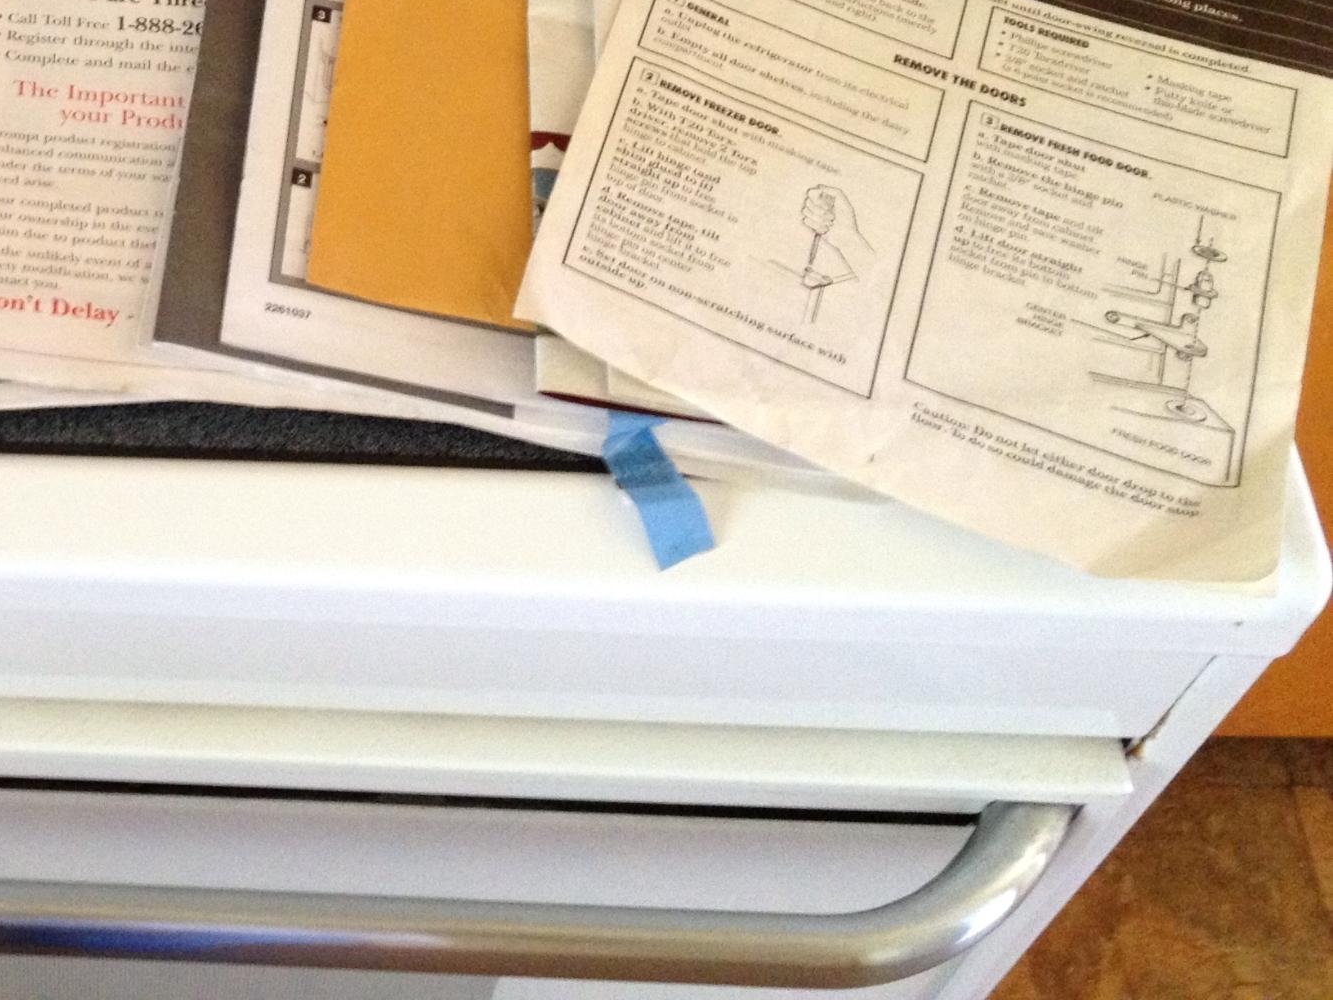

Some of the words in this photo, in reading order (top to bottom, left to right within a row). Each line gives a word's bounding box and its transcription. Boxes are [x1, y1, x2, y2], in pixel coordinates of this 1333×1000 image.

[8, 12, 37, 25] Call
[43, 13, 72, 28] Toll
[77, 17, 110, 29] Free
[686, 1, 731, 27] GENERAL
[6, 29, 67, 47] Register
[73, 35, 135, 53] through
[140, 39, 164, 52] the
[1003, 15, 1036, 36] TOOLS
[1037, 24, 1090, 50] REQUIRED
[5, 49, 77, 67] Complete
[84, 55, 114, 69] and
[119, 57, 152, 71] mail
[157, 59, 181, 73] the
[14, 79, 59, 100] The
[68, 83, 185, 109] Important
[894, 53, 950, 83] REMOVE
[952, 73, 978, 90] THE
[979, 81, 1027, 109] DOORS
[659, 78, 703, 106] REMOVE
[703, 96, 747, 123] FREEZER
[60, 109, 111, 126] your
[999, 122, 1047, 147] REMOVE
[1047, 137, 1081, 157] FRESH
[1082, 149, 1113, 169] FOOD
[51, 298, 120, 328] Delay
